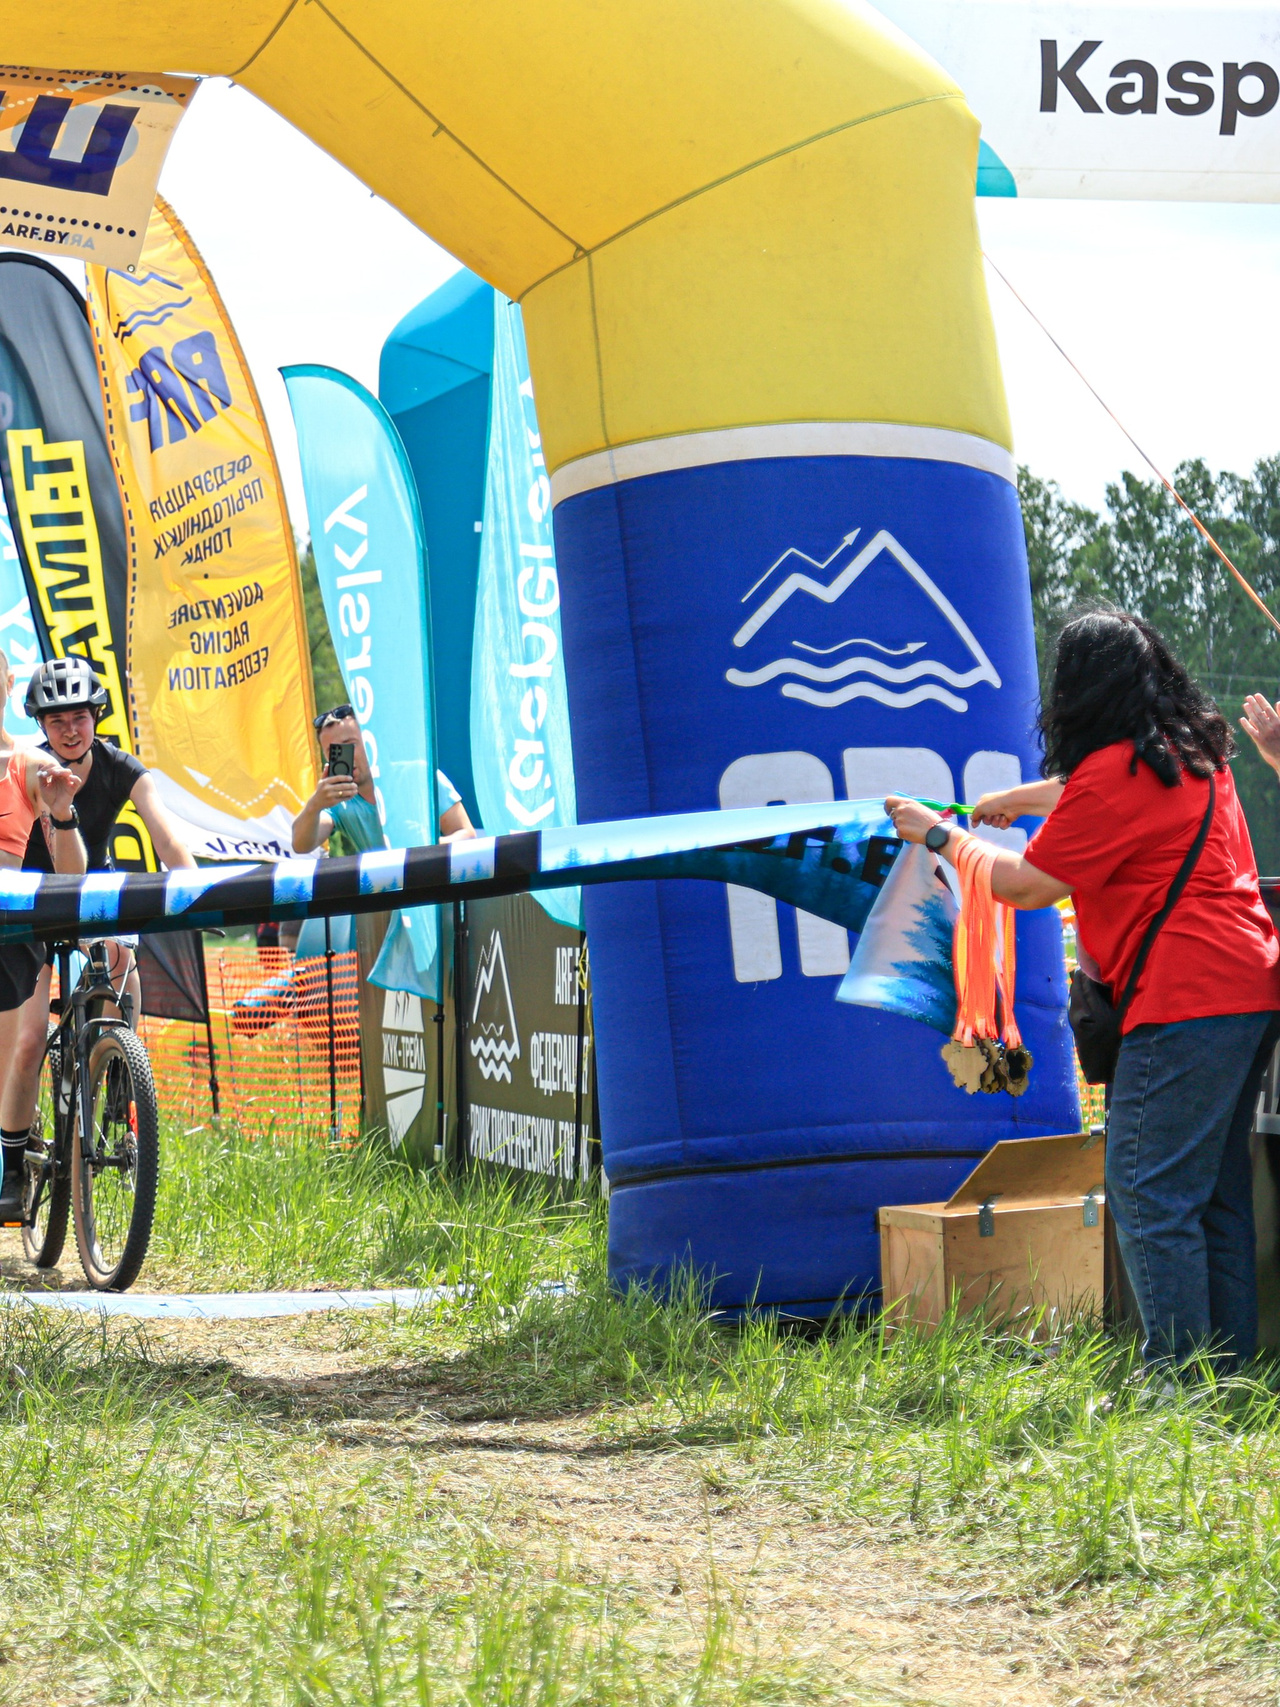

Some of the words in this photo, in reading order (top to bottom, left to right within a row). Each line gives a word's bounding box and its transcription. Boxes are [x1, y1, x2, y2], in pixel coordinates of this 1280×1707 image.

[1040, 39, 1280, 136] Kasp
[2, 223, 70, 244] ARF.BY
[530, 1032, 589, 1097] ФЕДЕРАЦЯ
[559, 1121, 589, 1183] ГОНК
